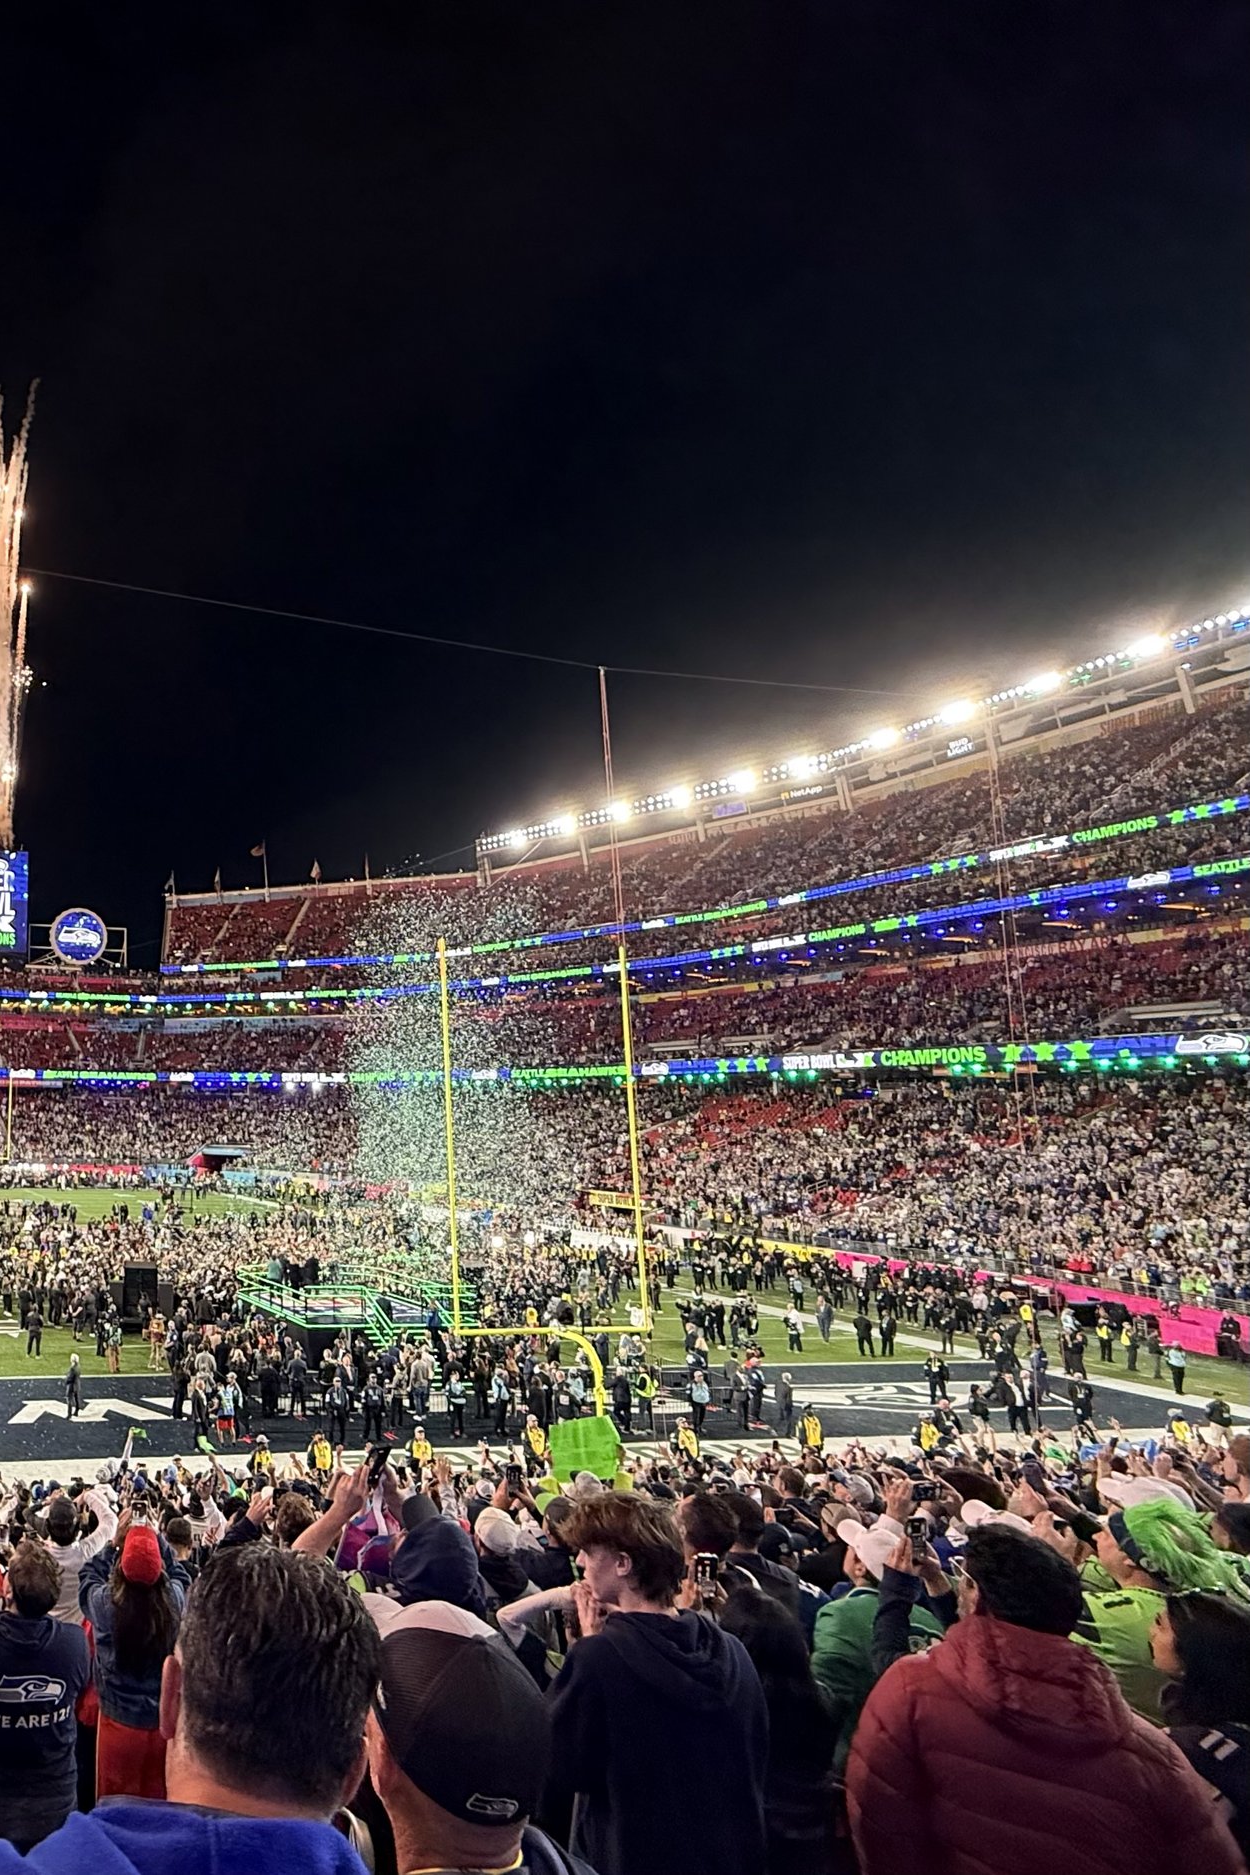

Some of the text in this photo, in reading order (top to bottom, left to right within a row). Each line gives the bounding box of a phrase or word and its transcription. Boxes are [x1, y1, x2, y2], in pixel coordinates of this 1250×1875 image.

[947, 737, 974, 757] BUD LIGHT
[790, 785, 824, 799] NetApp
[714, 802, 747, 817] VISA
[1072, 815, 1159, 844] CHAMPIONS
[1192, 858, 1250, 877] SEATTLE
[808, 923, 867, 943] CHAMPIONS
[1058, 937, 1087, 951] BAY
[1091, 933, 1132, 950] ARA
[782, 1055, 810, 1070] SUPER
[810, 1053, 837, 1069] BOWL
[880, 1045, 987, 1067] CHAMPIONS
[545, 1065, 628, 1078] SEAHAWKS
[14, 1713, 51, 1729] ARE
